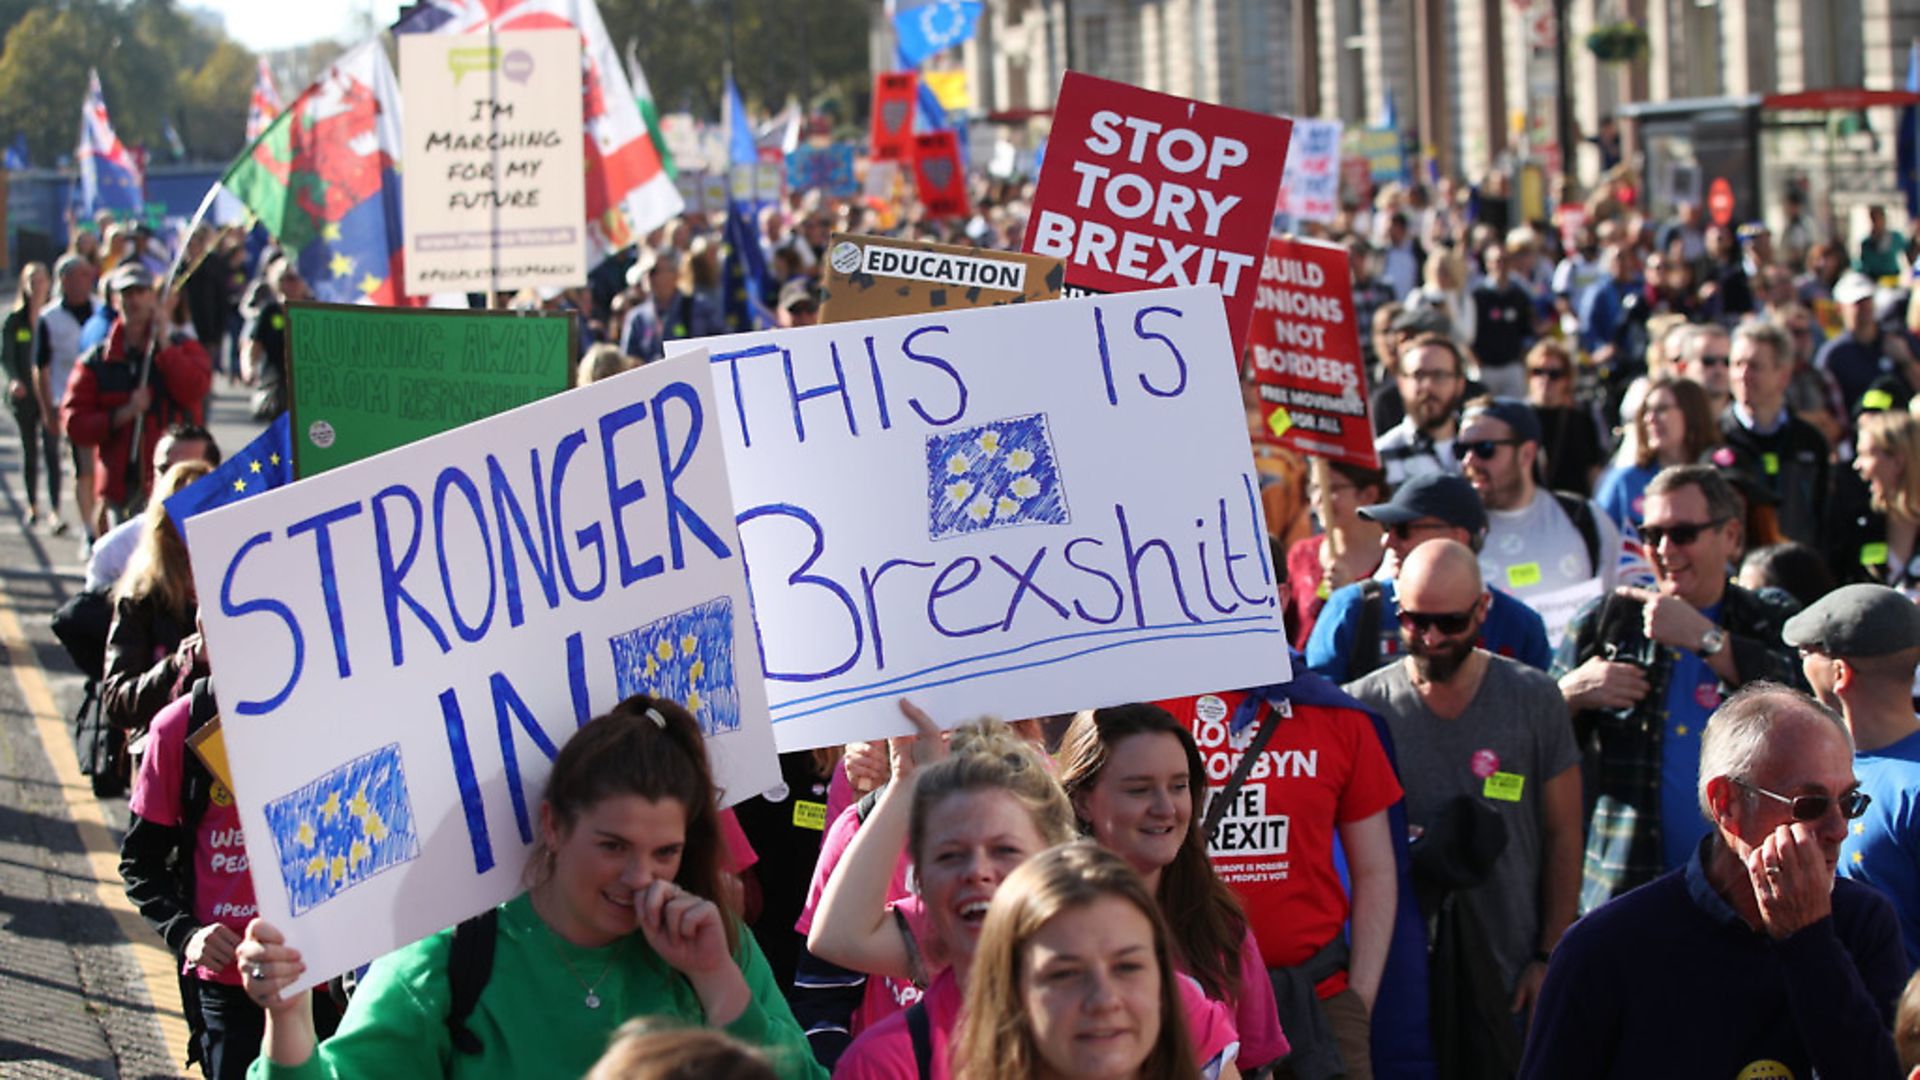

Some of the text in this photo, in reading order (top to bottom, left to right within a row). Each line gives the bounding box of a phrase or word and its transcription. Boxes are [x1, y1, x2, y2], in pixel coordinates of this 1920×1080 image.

[469, 99, 514, 122] I'M
[426, 130, 561, 152] MARCHING
[1084, 110, 1249, 181] STOP
[447, 160, 543, 182] FOR MY
[448, 189, 540, 211] FUTURE
[1073, 160, 1242, 237] TORY
[867, 250, 1021, 289] EDUCATION
[1032, 210, 1255, 297] BREXIT
[1261, 255, 1325, 289] BUILD
[295, 313, 563, 376] RUNNING AWAY
[1275, 319, 1326, 349] NOT
[710, 306, 1188, 447] THIS IS
[1254, 345, 1359, 386] BORDERS
[296, 366, 390, 414] FROM
[1318, 416, 1341, 434] ALL
[220, 381, 732, 715] STRONGER
[736, 473, 1276, 681] Brexshit!
[439, 632, 591, 874] IN
[1200, 749, 1317, 780] OBYN
[1207, 820, 1285, 851] REXIT
[210, 853, 249, 874] PEO
